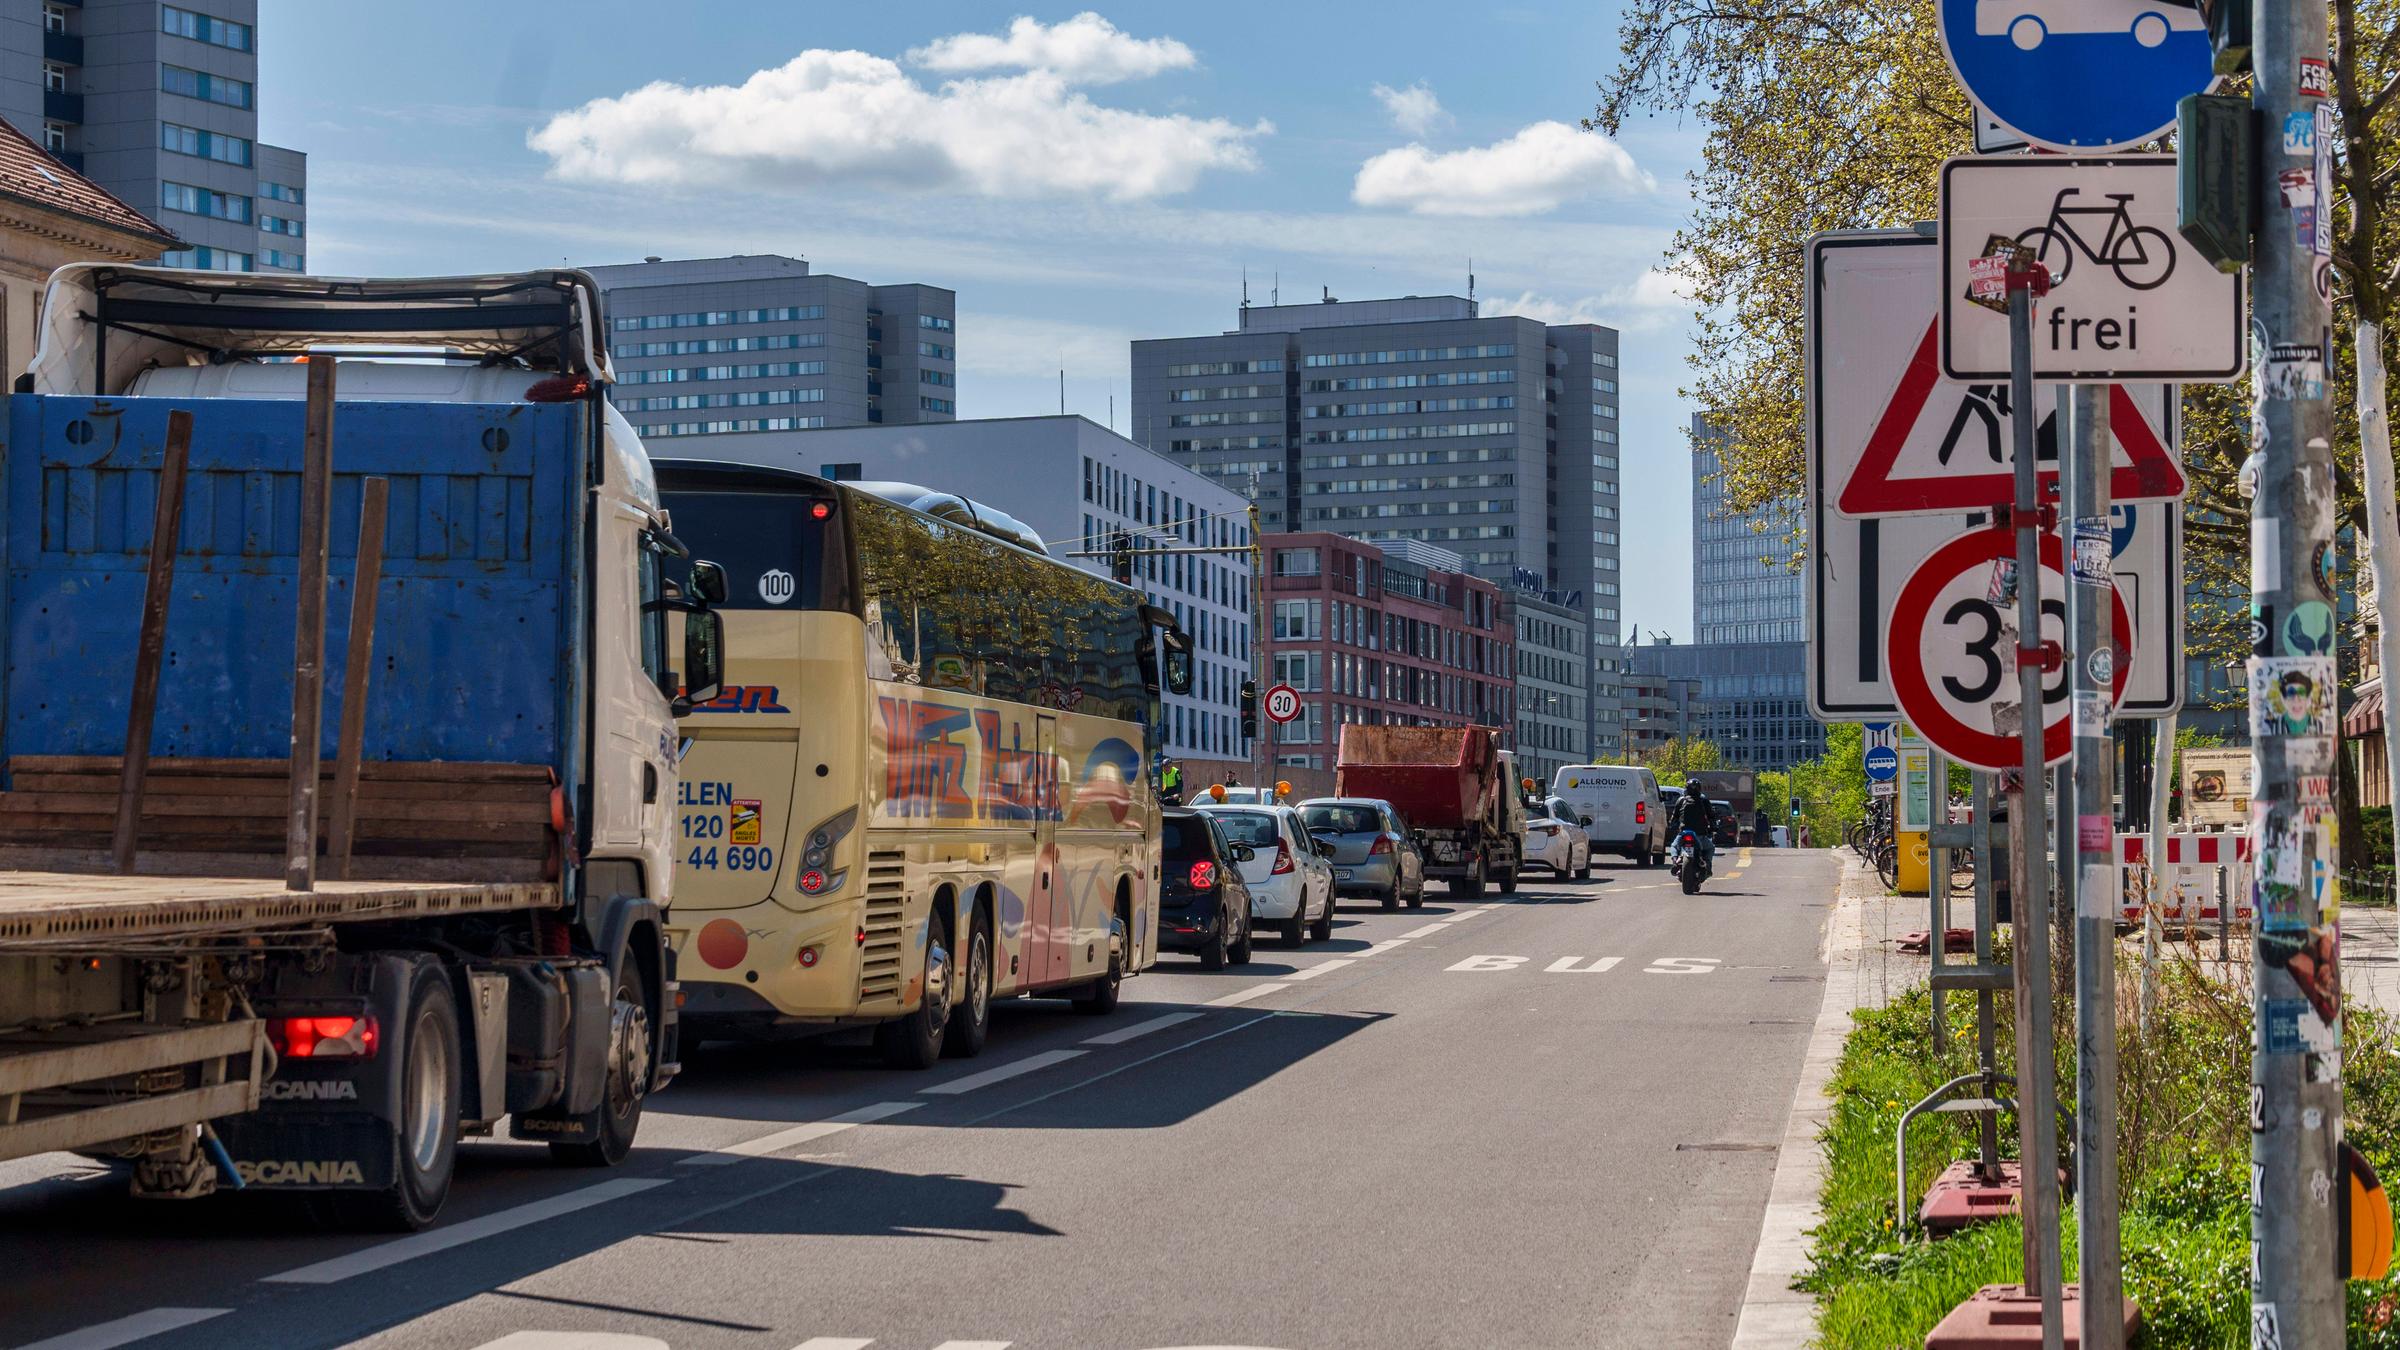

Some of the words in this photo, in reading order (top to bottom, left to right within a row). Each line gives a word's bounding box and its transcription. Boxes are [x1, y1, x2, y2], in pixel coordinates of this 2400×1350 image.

[2050, 306, 2138, 350] frei
[762, 574, 791, 597] 100
[1273, 695, 1291, 713] 30
[1579, 778, 1627, 786] ALLROUND
[1874, 785, 1891, 793] Ende
[682, 815, 723, 839] 120
[688, 847, 719, 870] 44
[727, 847, 773, 871] 690
[1443, 954, 1722, 974] BUS
[260, 1080, 357, 1100] SCANIA
[524, 1119, 584, 1133] SCANIA
[235, 1161, 364, 1184] SCANIA
